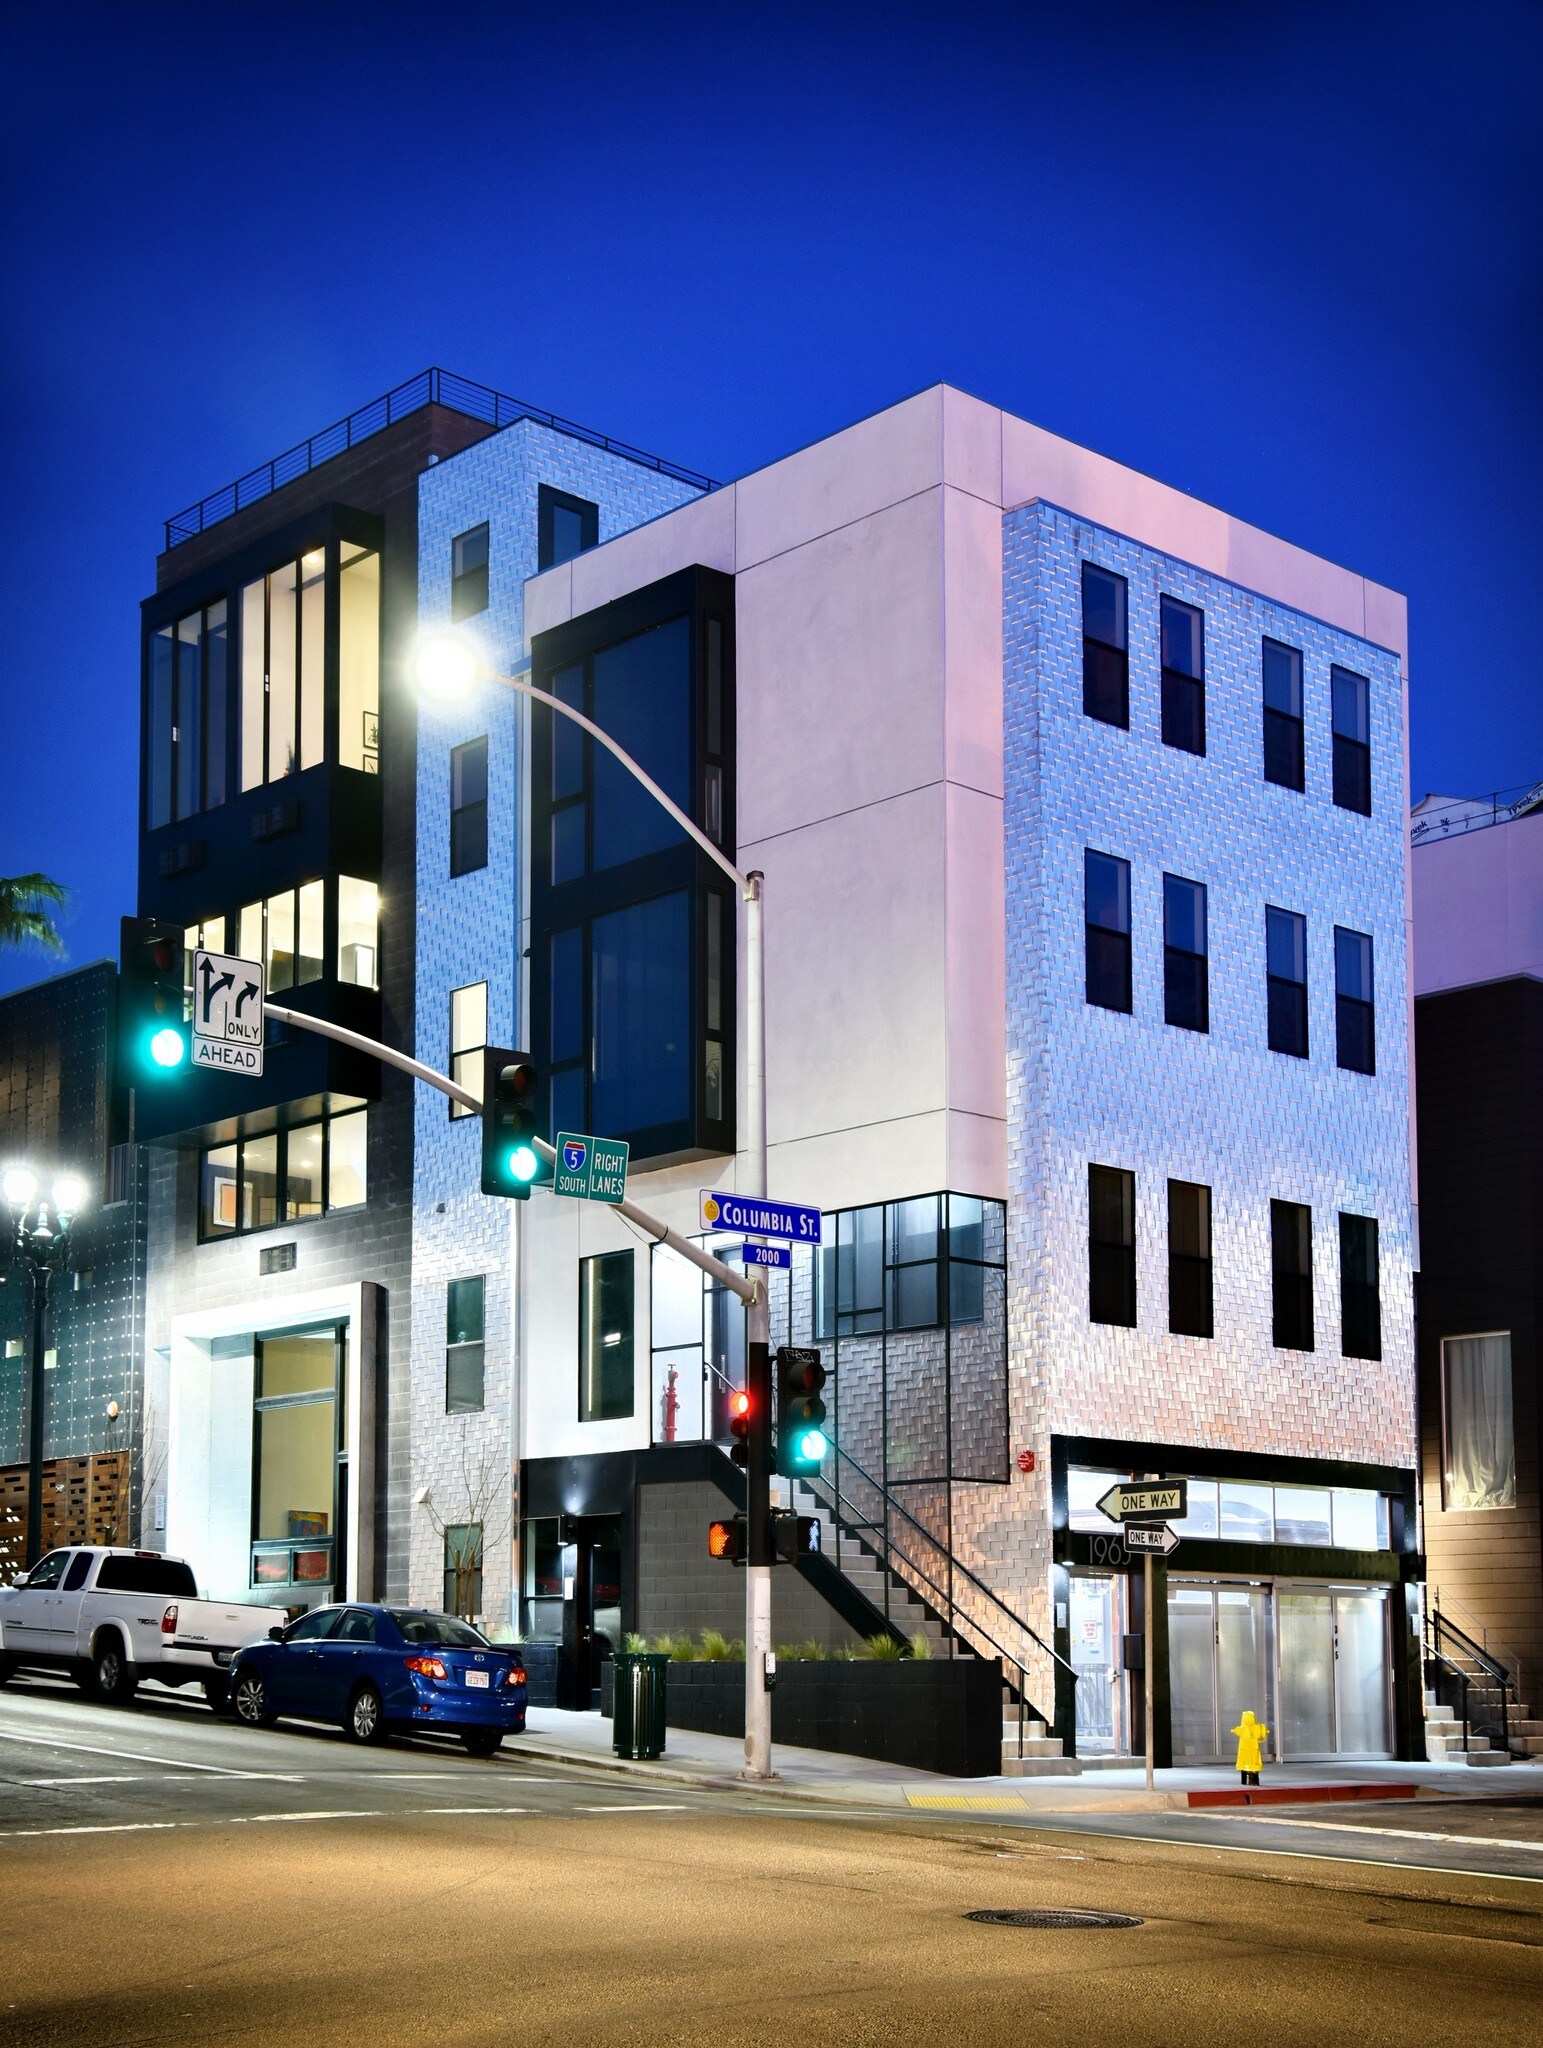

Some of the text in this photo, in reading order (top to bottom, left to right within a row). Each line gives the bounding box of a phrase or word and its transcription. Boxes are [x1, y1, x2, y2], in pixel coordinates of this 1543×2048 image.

[228, 1022, 259, 1039] ONLY
[199, 1044, 256, 1068] AHEAD
[570, 1151, 578, 1168] 5
[594, 1153, 624, 1173] RIGHT
[559, 1175, 586, 1193] SOUTH
[591, 1174, 624, 1196] LANES
[722, 1202, 793, 1233] COLUMBIA
[756, 1248, 780, 1265] 2000
[1121, 1492, 1176, 1510] ONE WAY
[1130, 1531, 1164, 1545] ONE WAY
